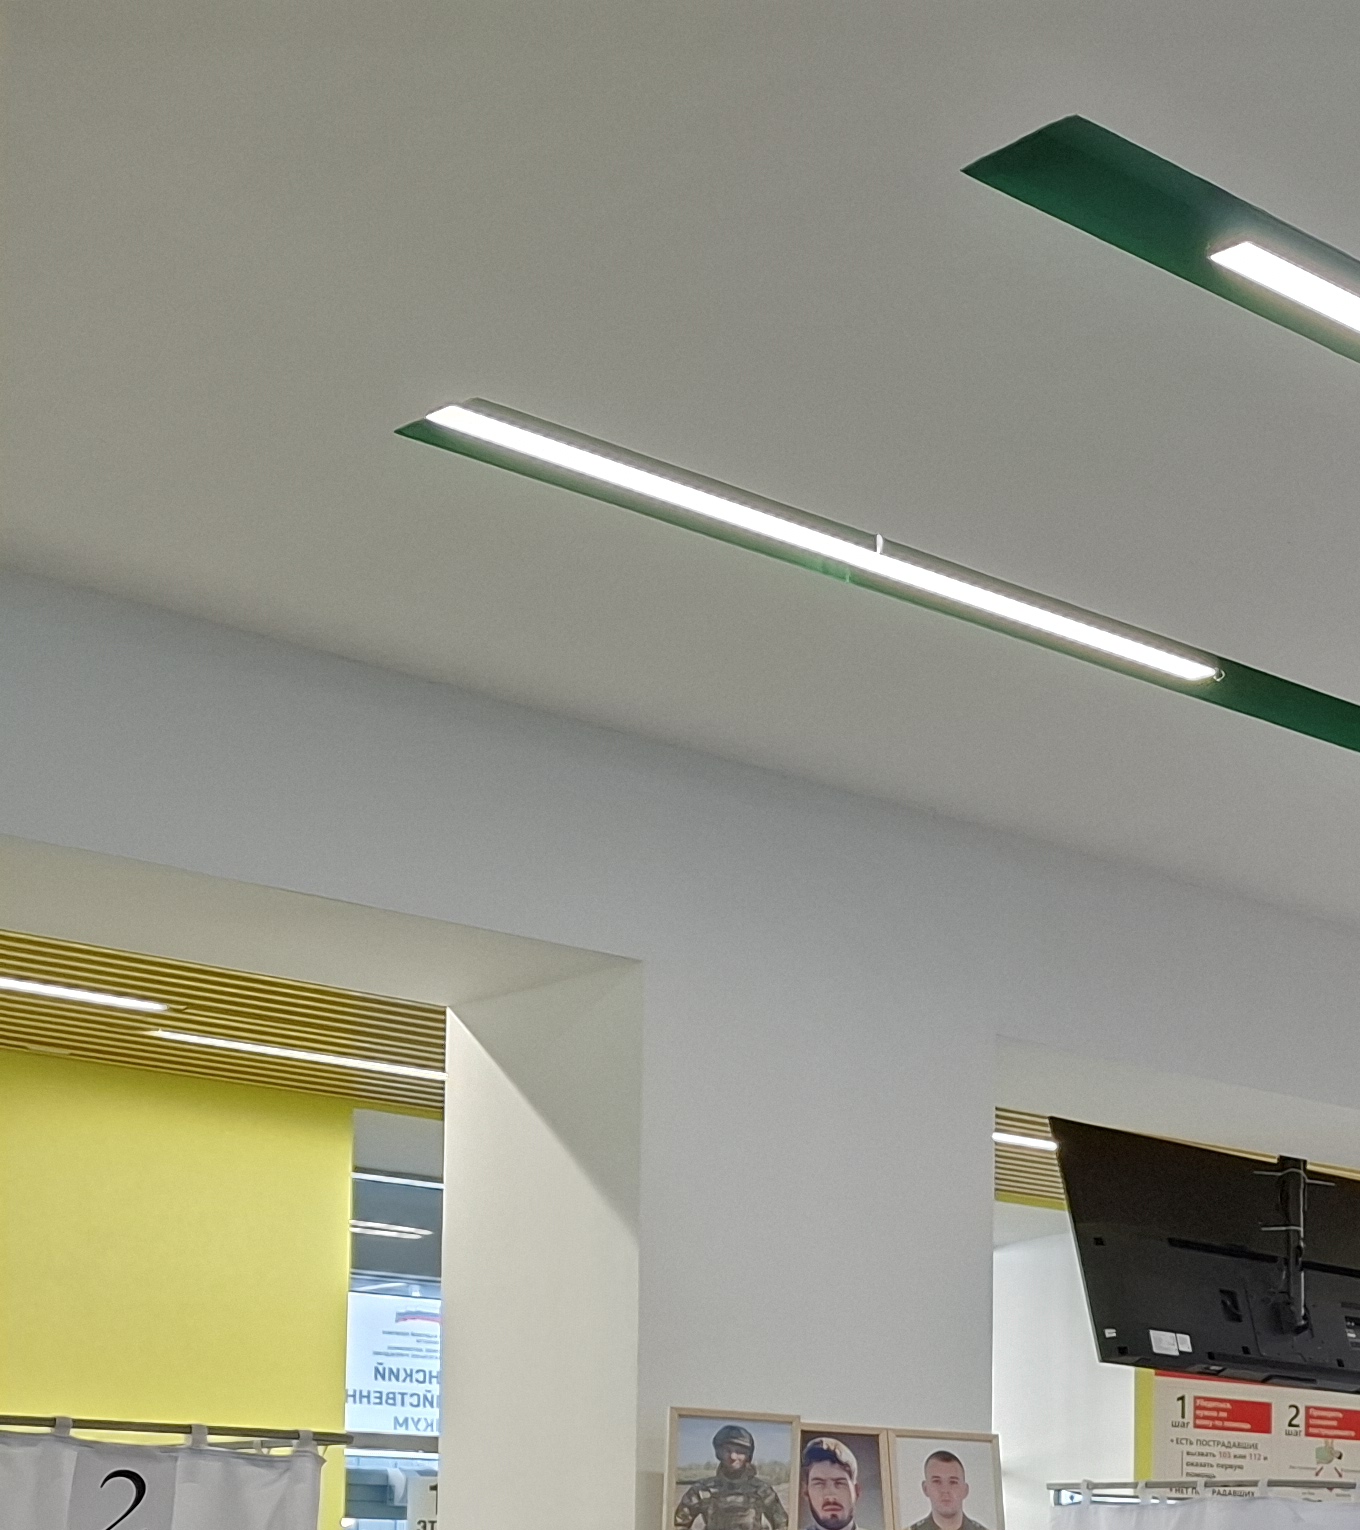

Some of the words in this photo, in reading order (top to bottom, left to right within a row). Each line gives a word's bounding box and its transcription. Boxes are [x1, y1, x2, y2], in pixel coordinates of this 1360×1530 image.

[1176, 1394, 1186, 1419] 1
[1287, 1404, 1300, 1428] 2
[1171, 1420, 1190, 1429] шаг
[1284, 1429, 1302, 1437] шаг
